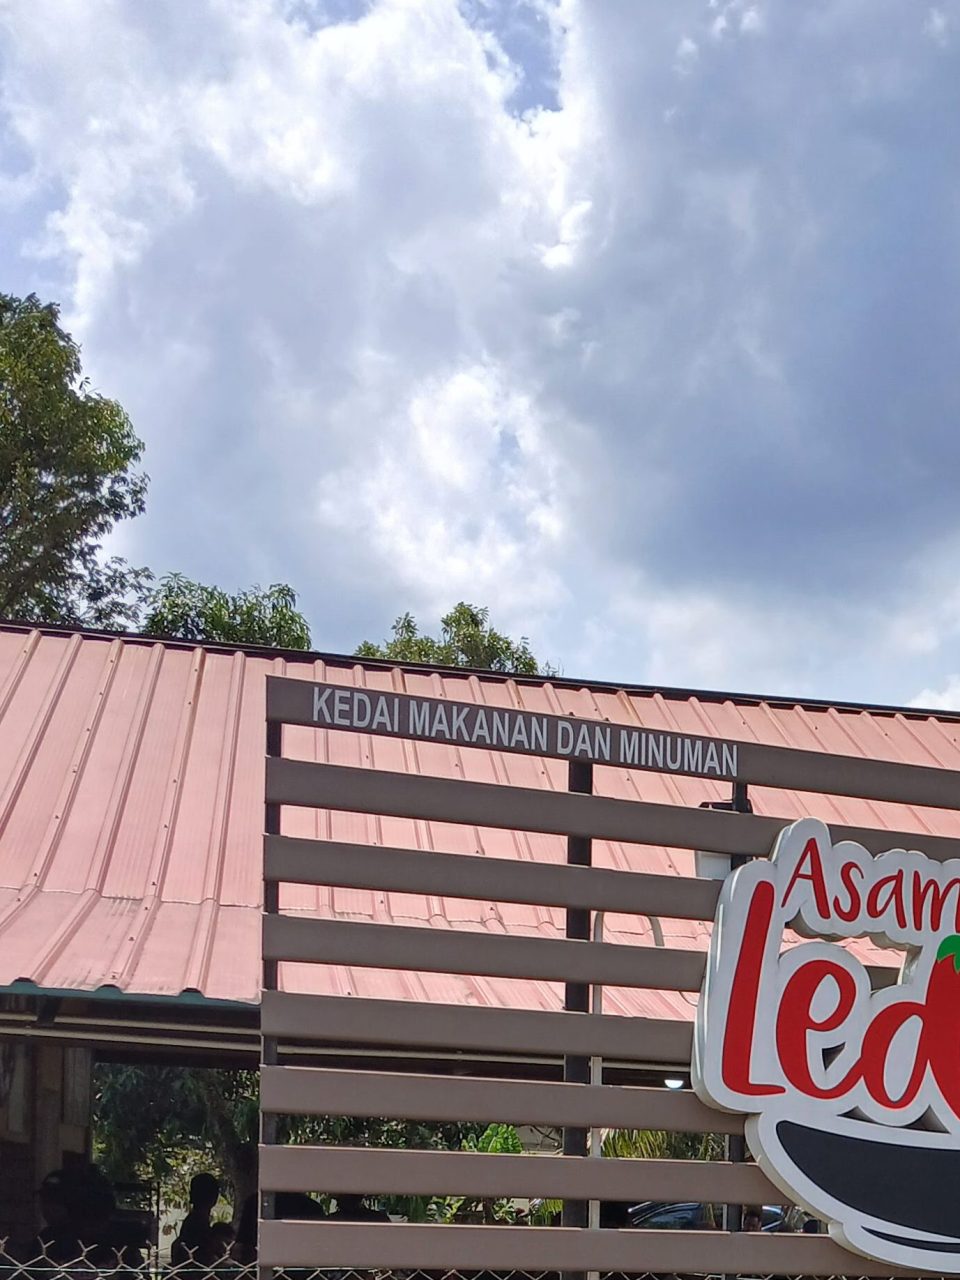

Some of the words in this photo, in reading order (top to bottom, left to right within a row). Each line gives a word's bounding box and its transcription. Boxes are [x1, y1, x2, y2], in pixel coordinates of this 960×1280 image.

[312, 686, 400, 733] KEDAI
[408, 699, 548, 751] MAKANAN
[556, 720, 612, 761] DAN
[619, 729, 738, 777] MINUMAN
